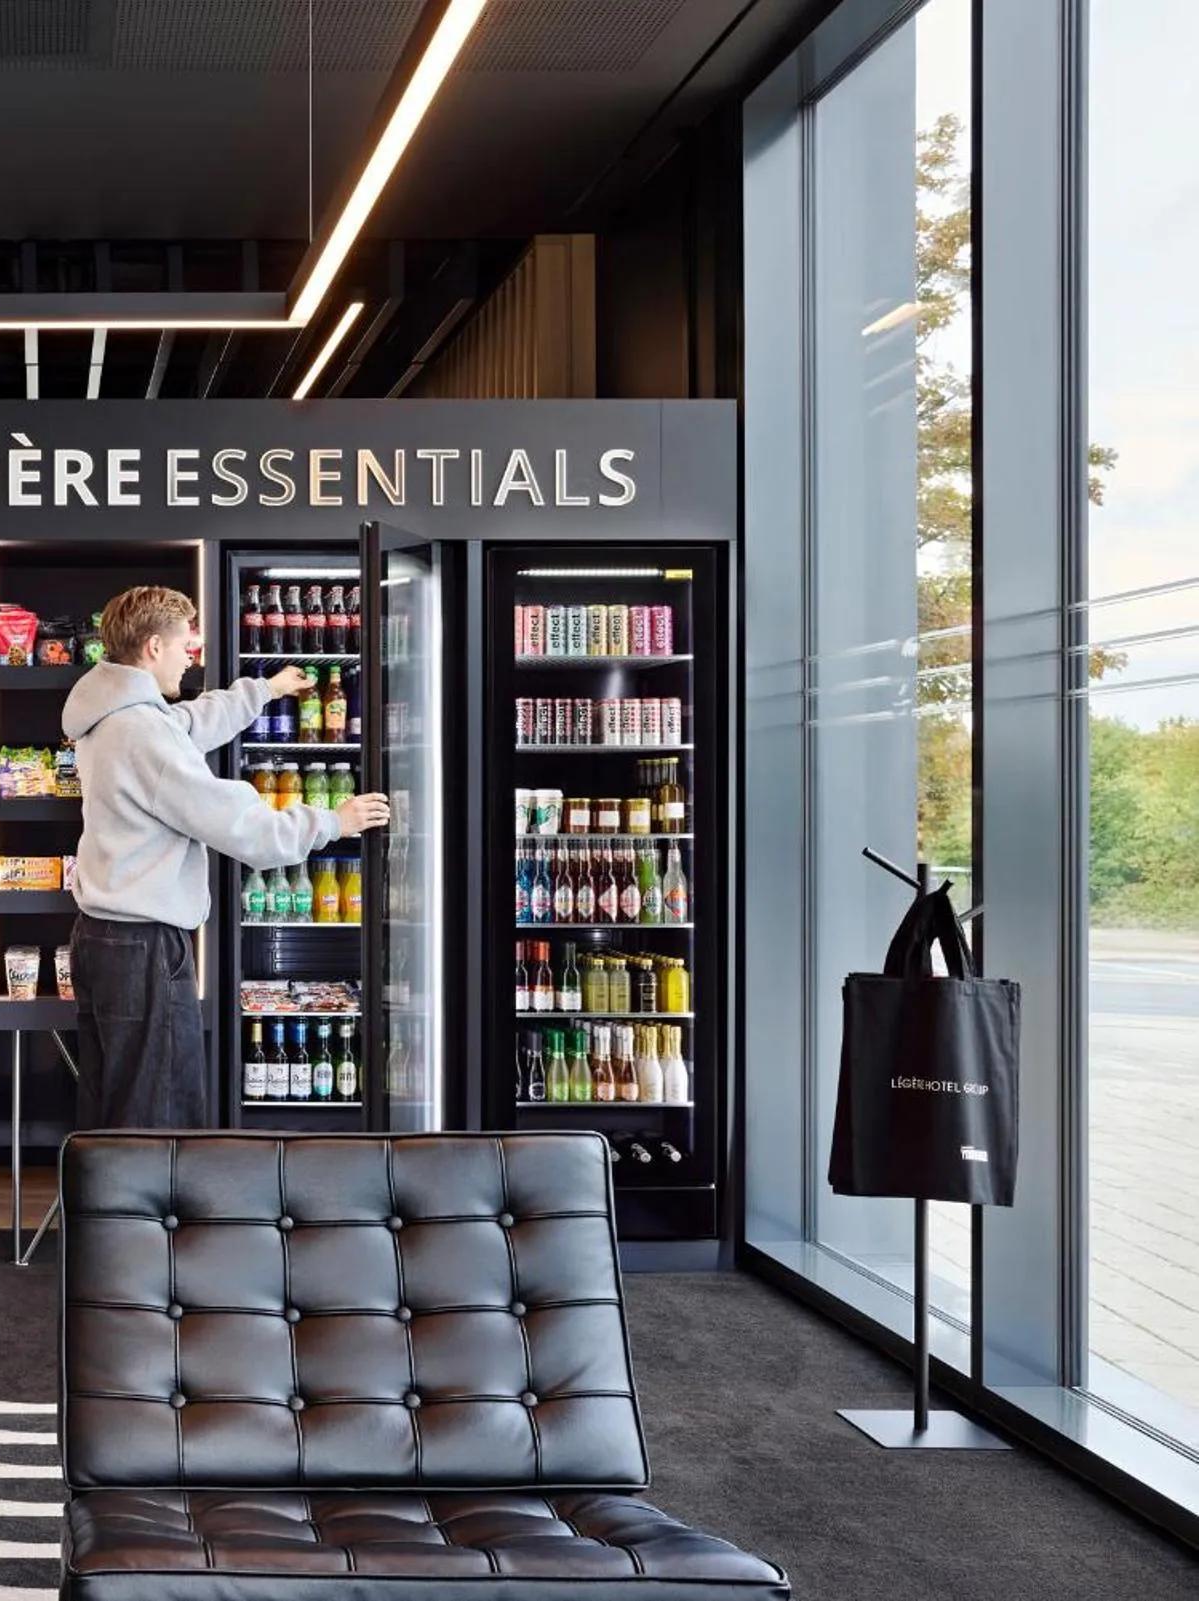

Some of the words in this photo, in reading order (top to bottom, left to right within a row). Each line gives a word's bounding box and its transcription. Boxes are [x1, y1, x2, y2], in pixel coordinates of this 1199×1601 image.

[165, 447, 638, 507] ESSENTIALS
[550, 614, 560, 649] effect
[571, 614, 581, 649] effect
